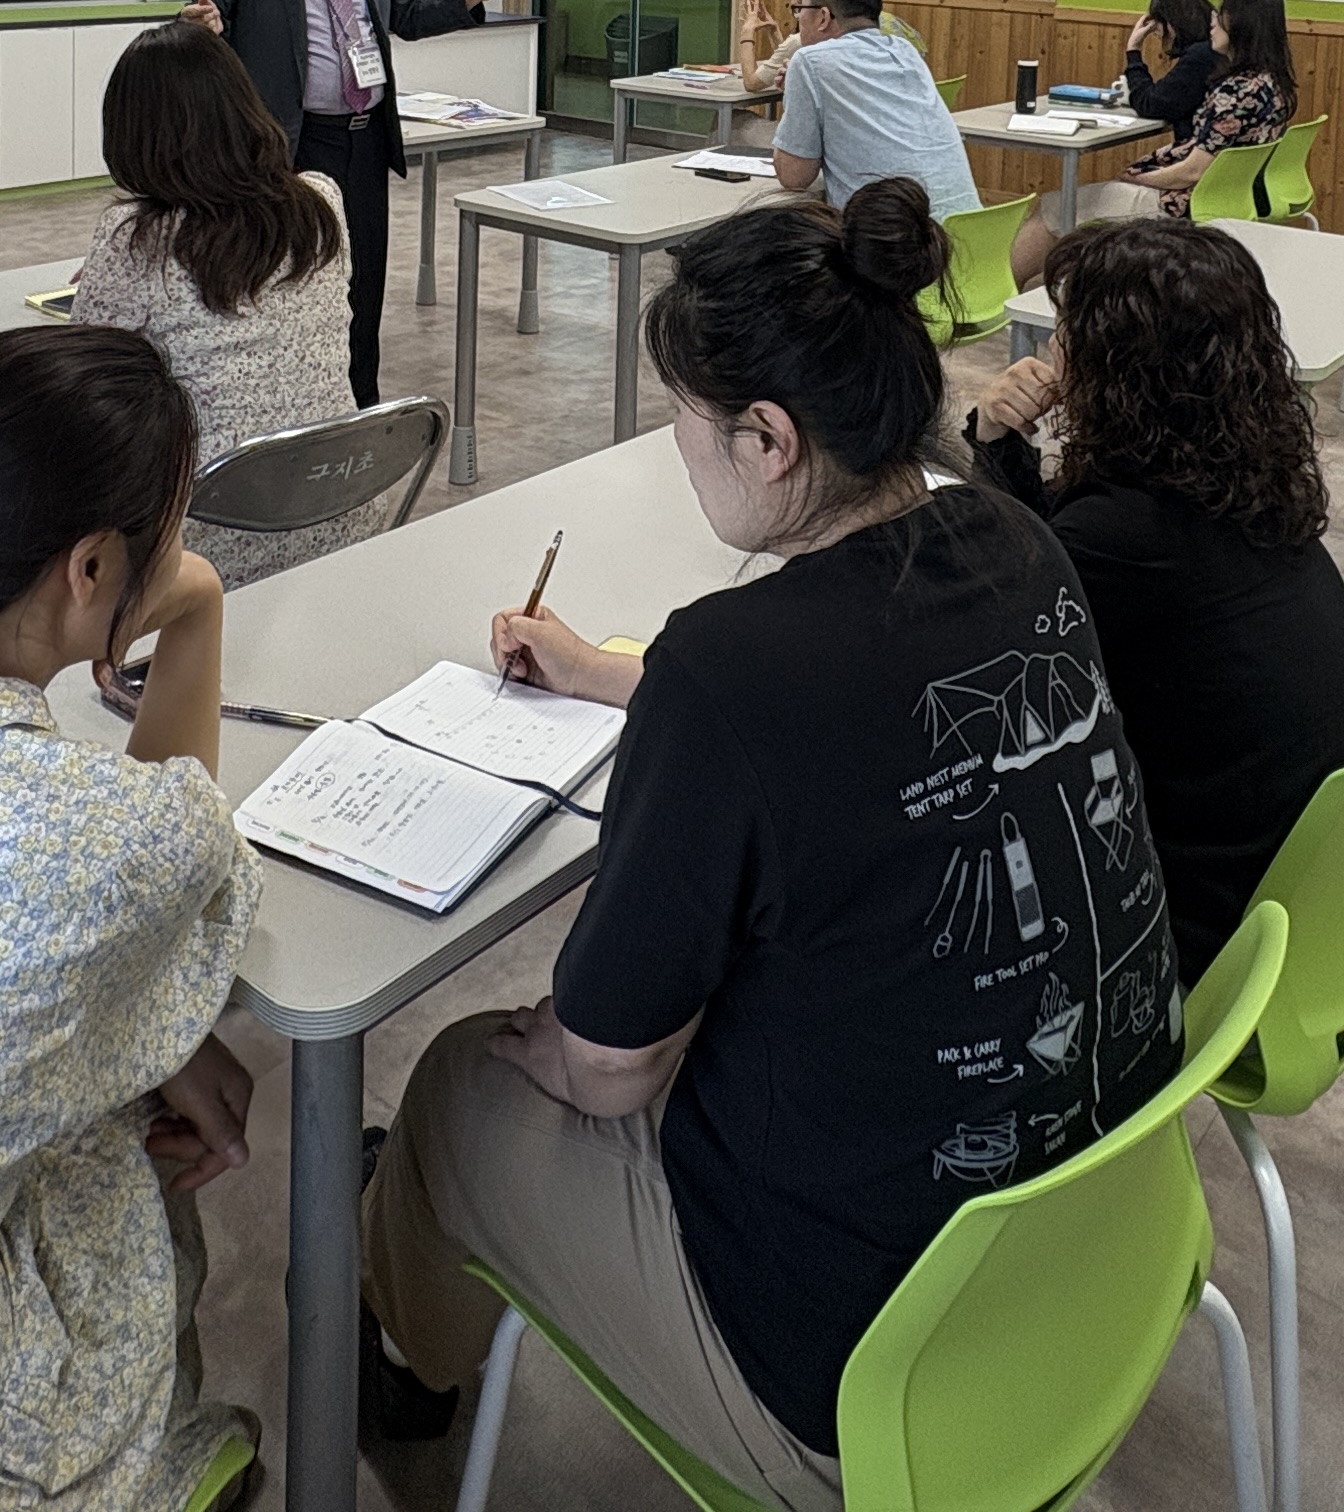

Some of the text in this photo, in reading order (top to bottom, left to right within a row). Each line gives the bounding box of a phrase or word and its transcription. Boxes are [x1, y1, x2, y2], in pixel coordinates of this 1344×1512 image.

[899, 782, 924, 800] LAND
[926, 767, 949, 791] NEST
[904, 778, 972, 820] TENT TARP SET
[974, 974, 994, 992] FIRE
[995, 965, 1018, 982] TOOL
[1018, 955, 1034, 975] SET
[937, 1047, 961, 1064] PACK
[974, 1038, 1001, 1058] CARRY
[957, 1056, 1004, 1080] FIREPLACE
